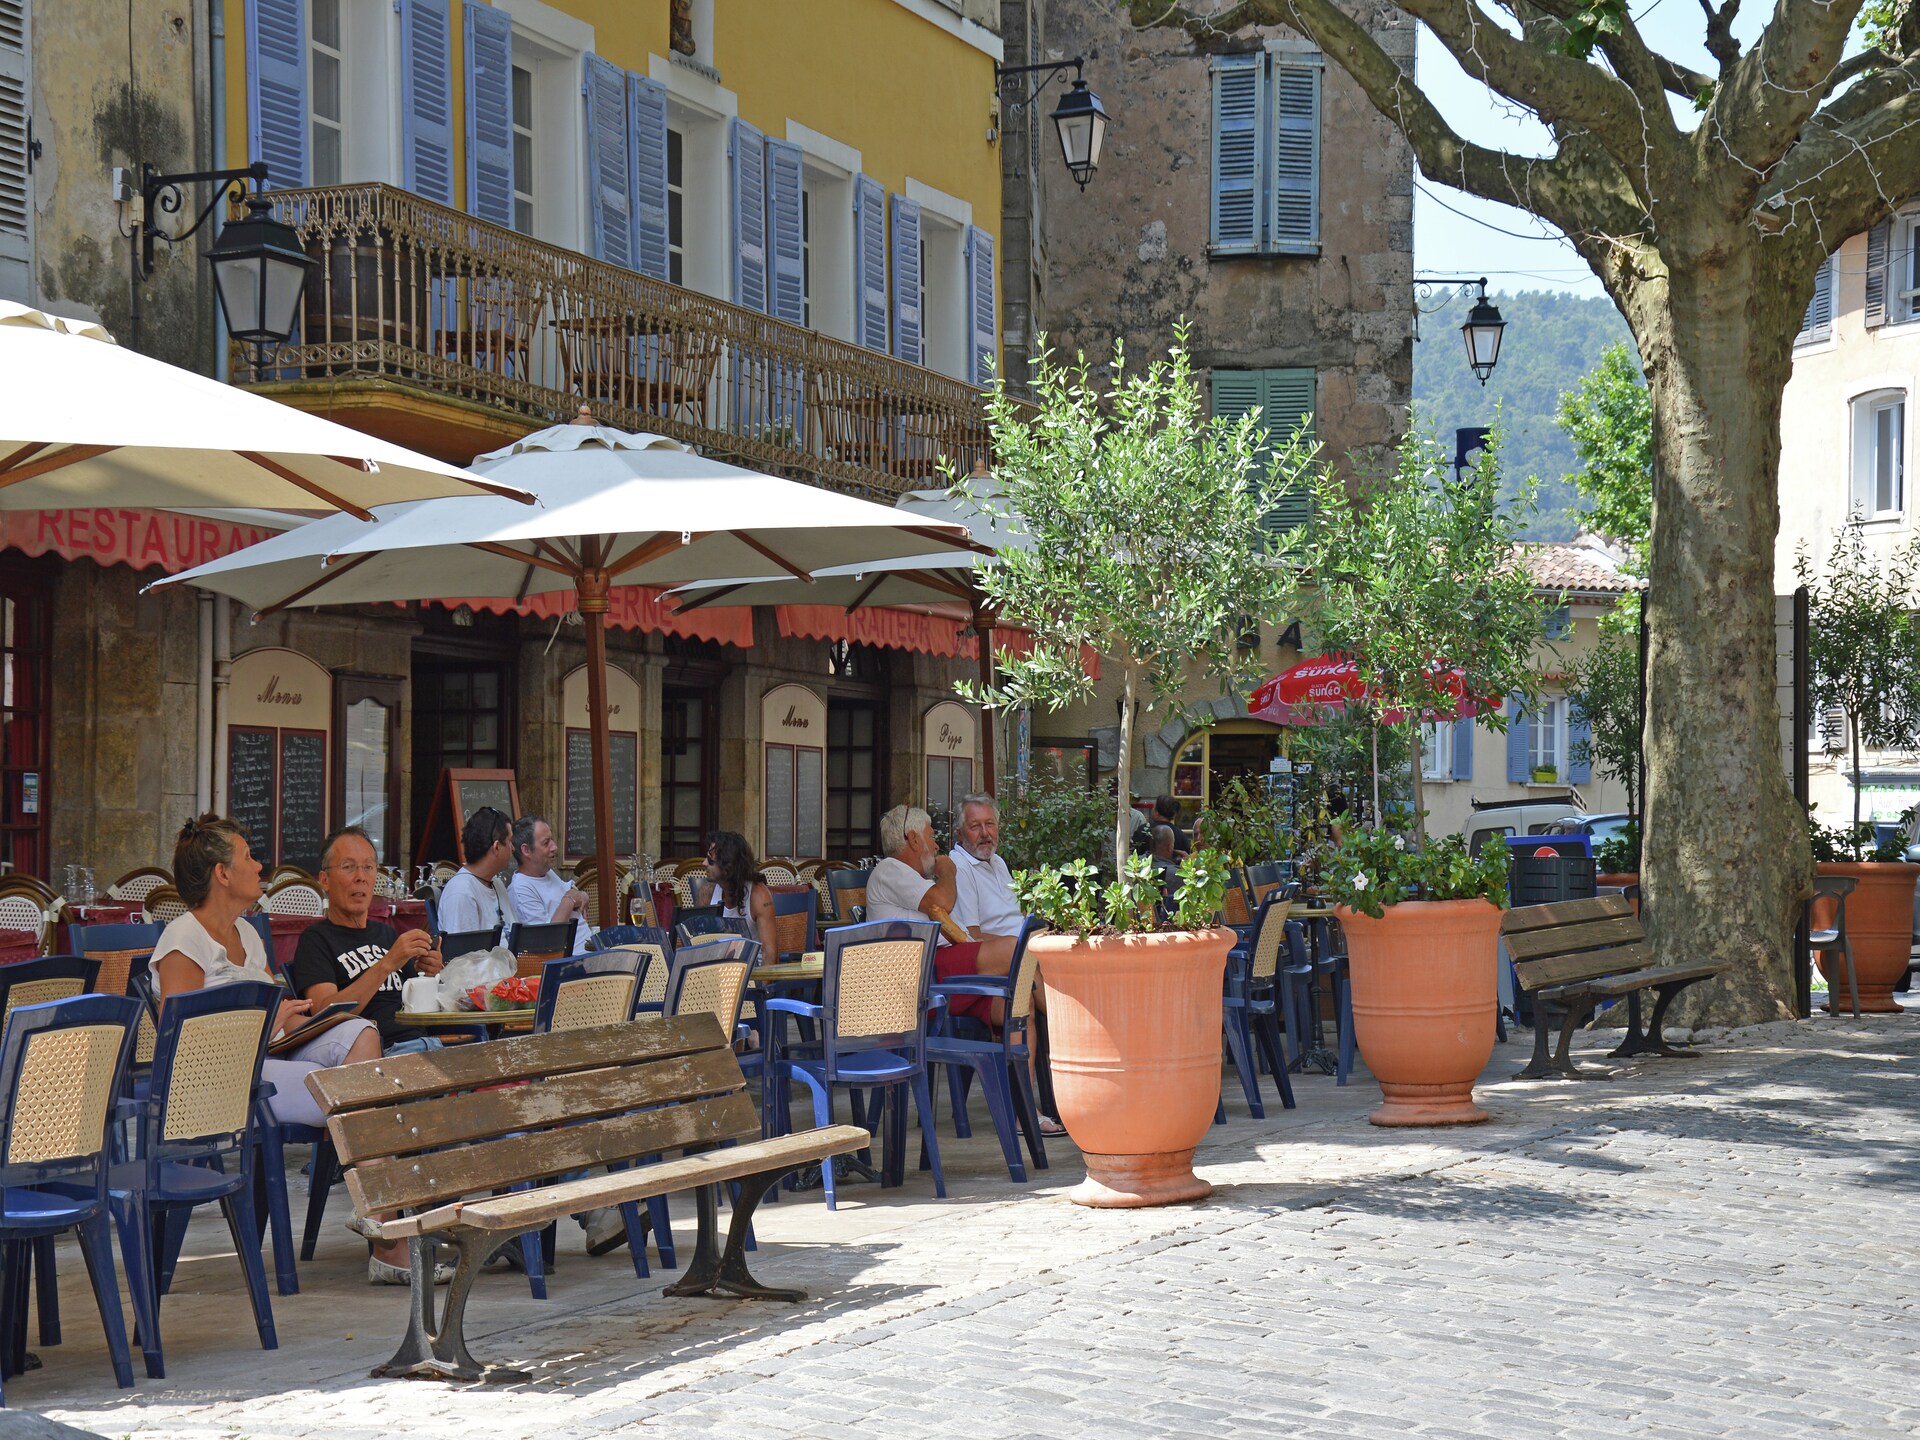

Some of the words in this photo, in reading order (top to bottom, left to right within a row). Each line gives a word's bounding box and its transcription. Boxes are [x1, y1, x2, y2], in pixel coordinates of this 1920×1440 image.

[38, 508, 284, 564] RESTAURA
[257, 674, 302, 705] Menu
[782, 704, 809, 728] Menu
[337, 944, 389, 980] DIES
